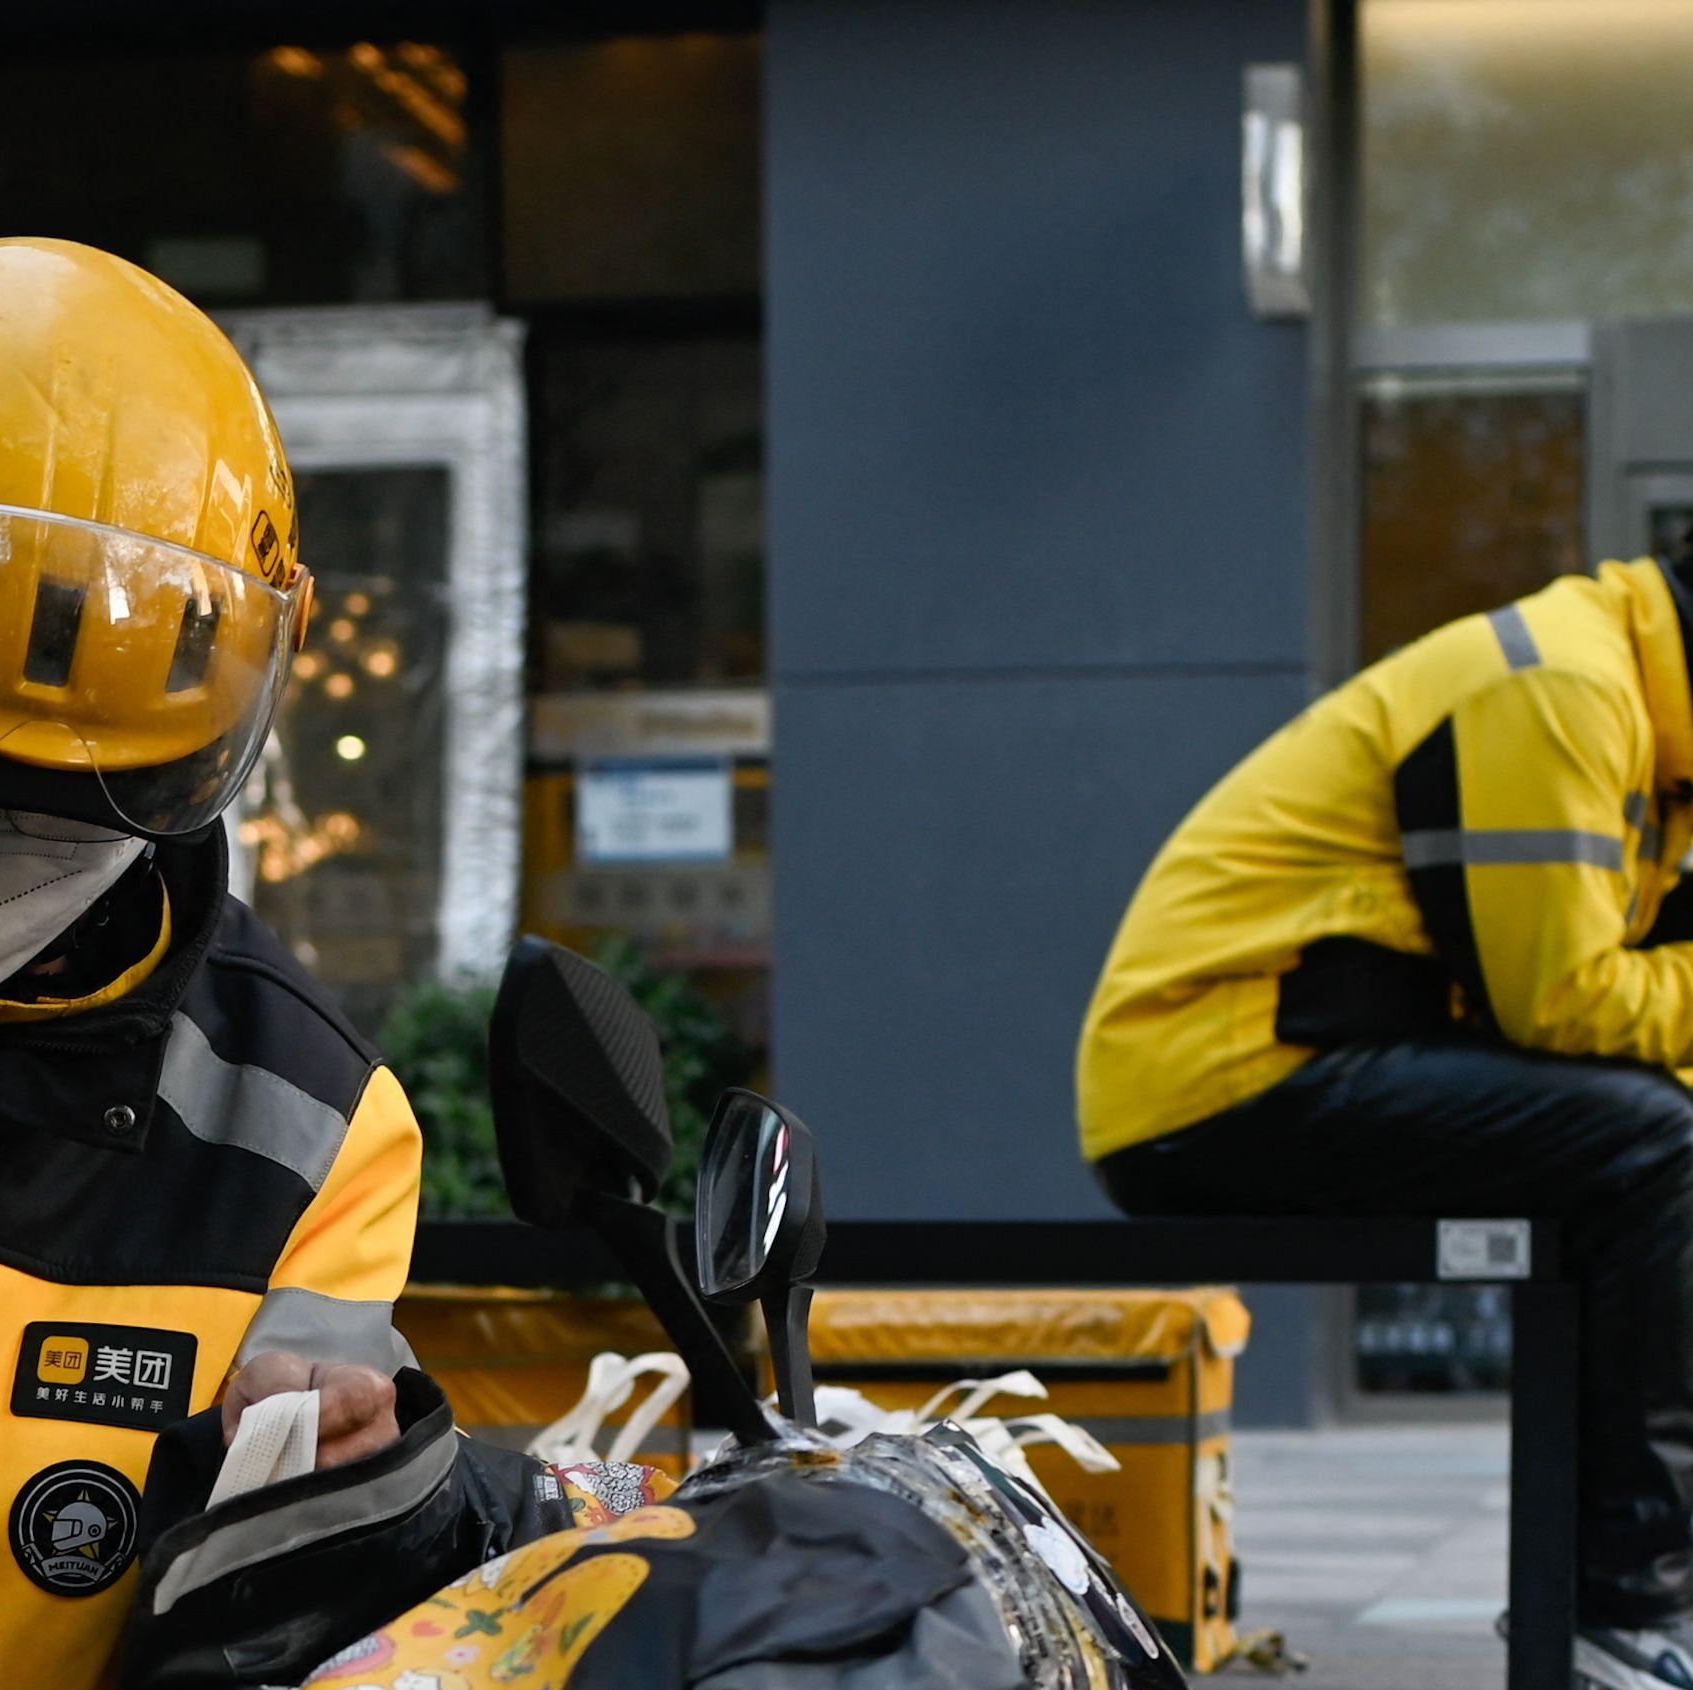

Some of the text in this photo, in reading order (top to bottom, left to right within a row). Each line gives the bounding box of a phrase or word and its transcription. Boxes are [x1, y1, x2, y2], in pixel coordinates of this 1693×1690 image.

[43, 1350, 83, 1370] 美团
[93, 1345, 173, 1391] 美团
[36, 1386, 164, 1414] 美好生活小帮手
[48, 1560, 99, 1576] MEITUAN
